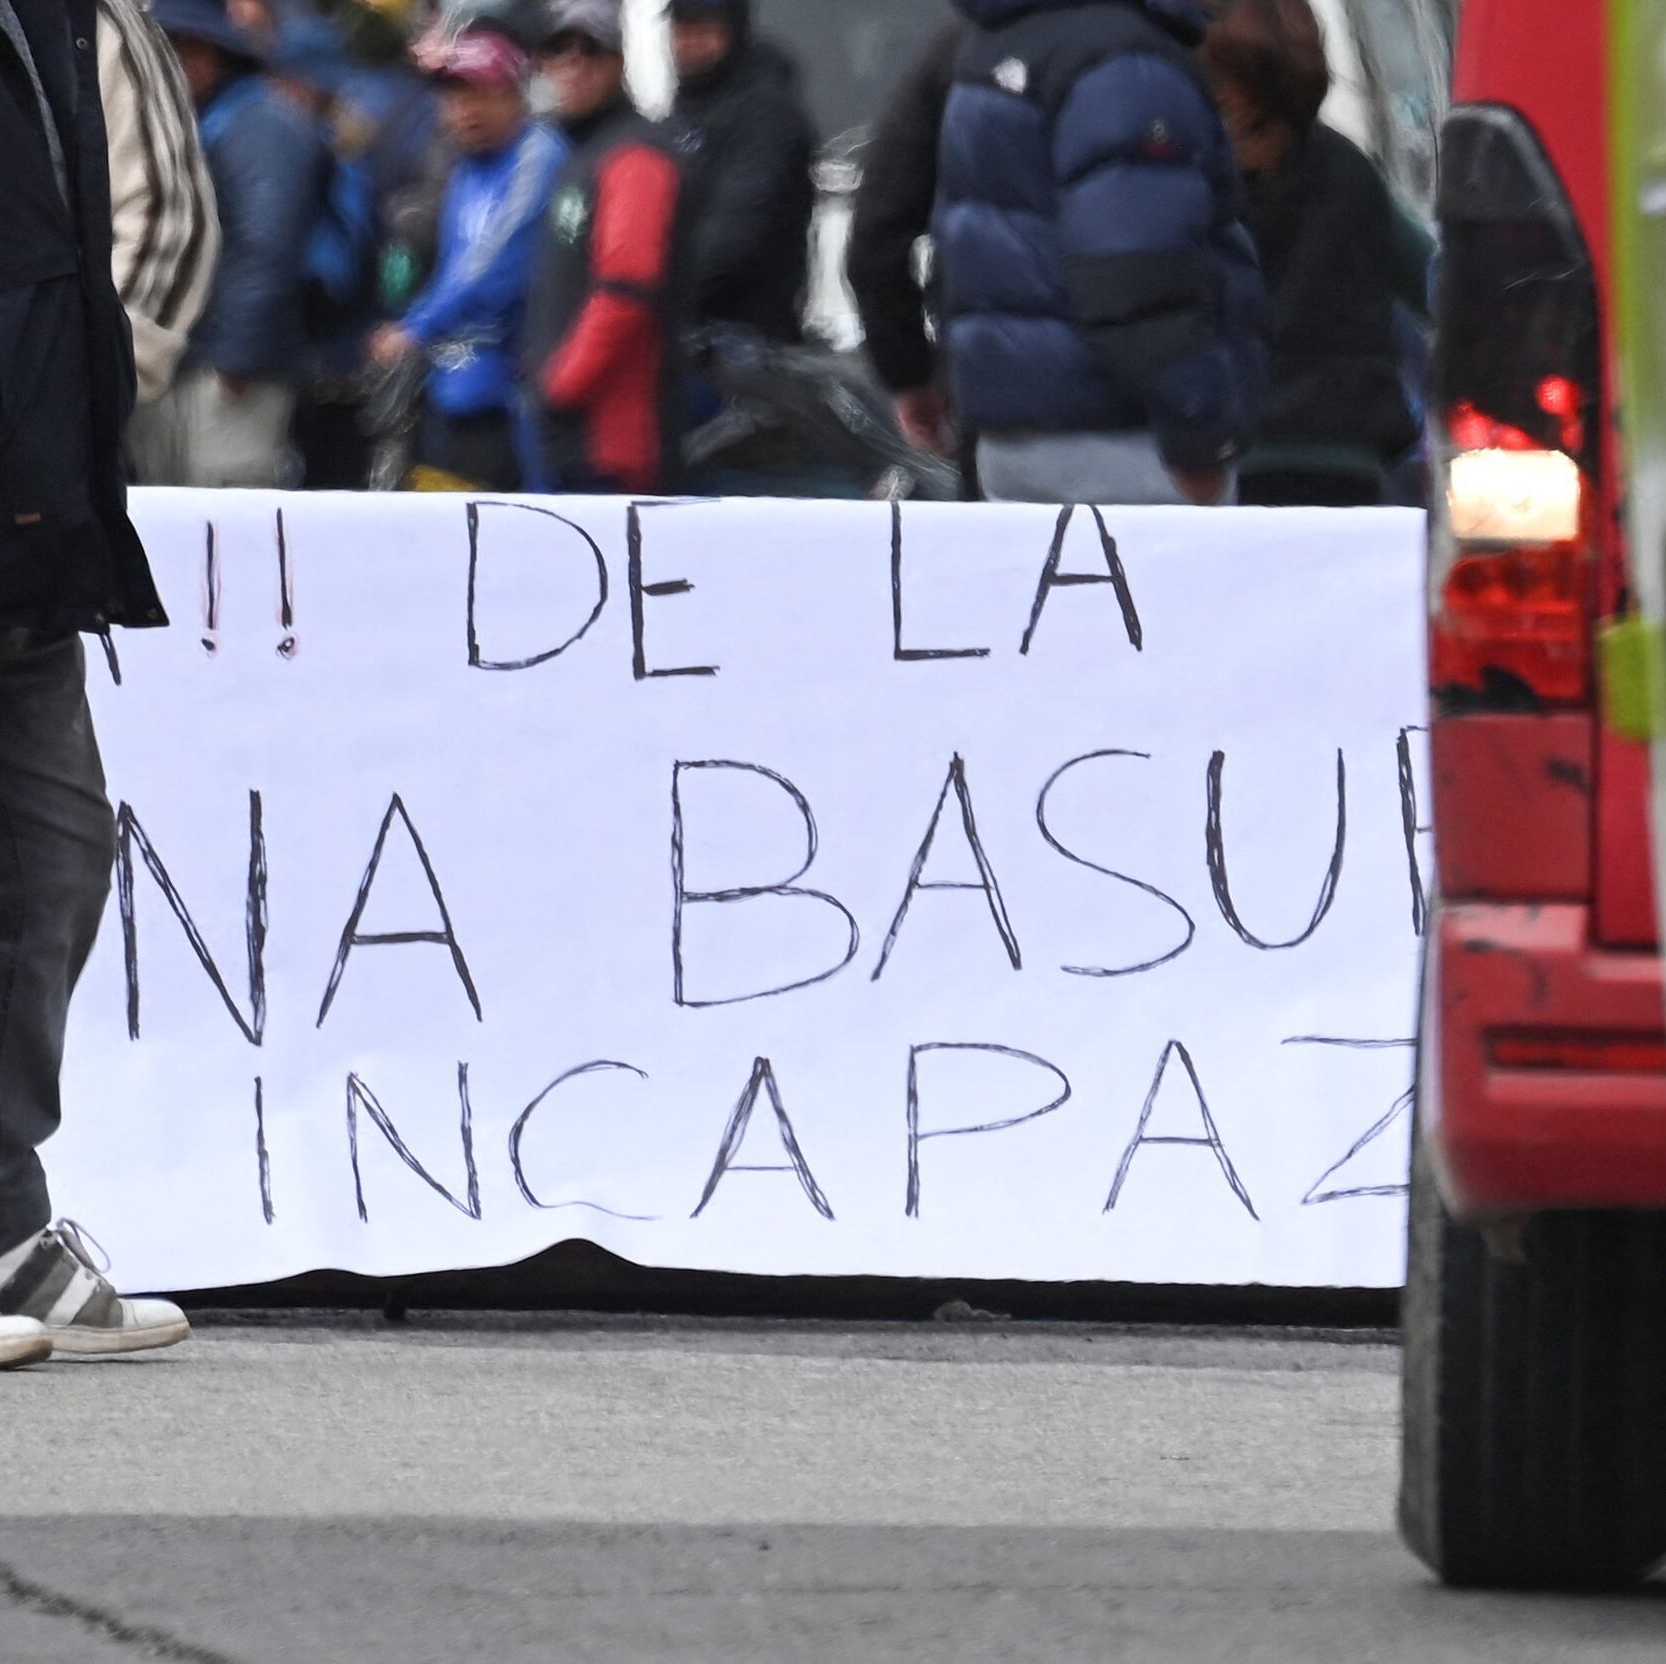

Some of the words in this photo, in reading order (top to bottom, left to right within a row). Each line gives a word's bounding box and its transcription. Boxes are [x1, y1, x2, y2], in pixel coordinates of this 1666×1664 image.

[465, 496, 721, 680] DE
[890, 501, 1143, 661] LA
[254, 1038, 1419, 1225] INCAPAZ
